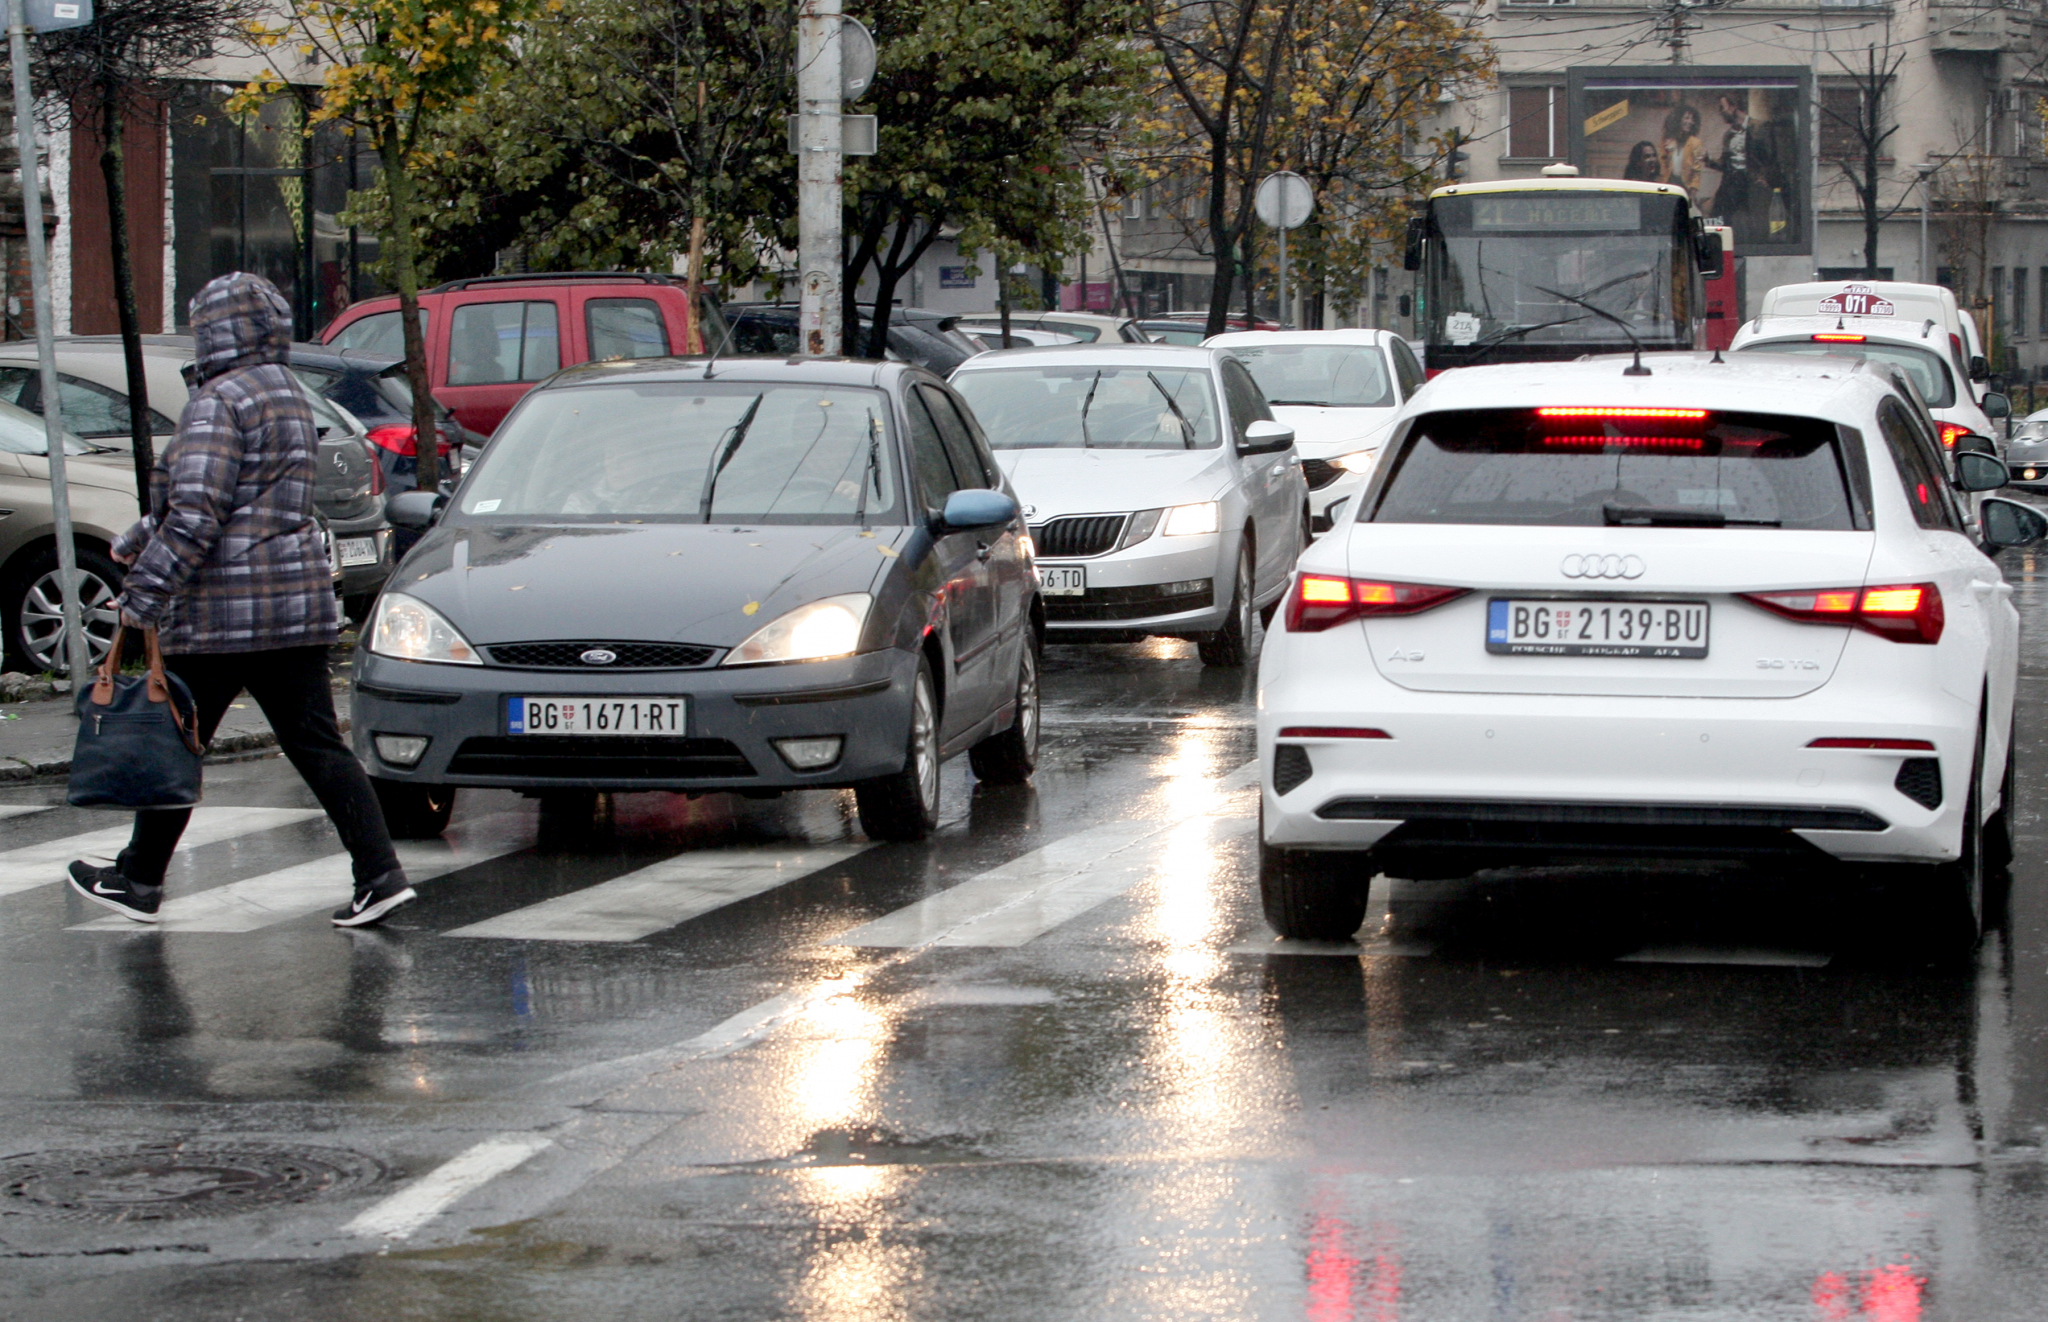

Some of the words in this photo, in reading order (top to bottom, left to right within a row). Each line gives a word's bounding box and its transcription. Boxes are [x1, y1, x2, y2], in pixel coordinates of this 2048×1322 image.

[1845, 295, 1867, 313] 071
[1514, 607, 1550, 638] BG
[1387, 647, 1425, 662] A3
[529, 703, 558, 729] BG
